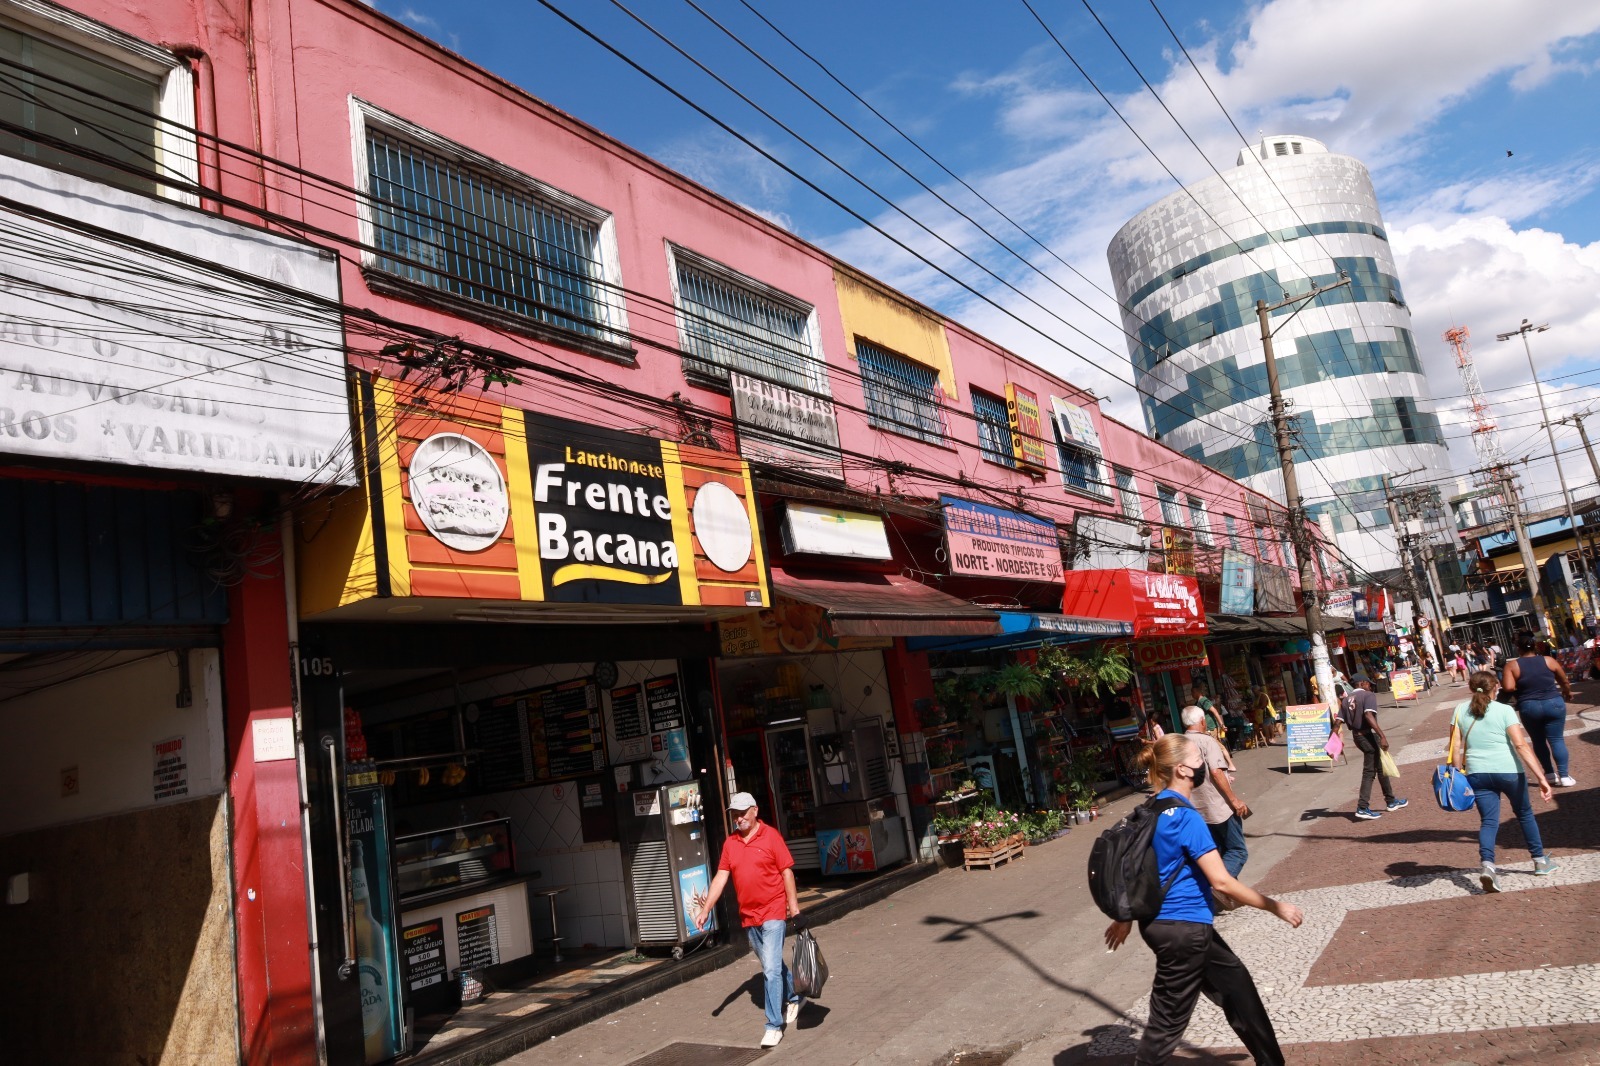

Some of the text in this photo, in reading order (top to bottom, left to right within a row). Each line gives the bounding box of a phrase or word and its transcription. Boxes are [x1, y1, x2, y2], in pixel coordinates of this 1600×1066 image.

[735, 375, 833, 415] DENTISTAS
[565, 445, 664, 480] Lanchonete
[534, 463, 672, 521] Frente
[539, 513, 679, 569] Bacana
[971, 538, 1045, 558] PRODUTOS TÍPICOS DO
[955, 552, 990, 571] NORTE
[995, 558, 1039, 576] NORDESTE
[1040, 564, 1046, 576] E
[1047, 563, 1062, 578] SUL
[723, 627, 747, 640] Caldo
[726, 639, 759, 653] de Cana
[1141, 639, 1204, 663] OURO
[301, 657, 334, 677] 105
[350, 817, 375, 835] ELADA
[404, 939, 443, 956] PÃO DE QUEIJO
[414, 961, 437, 973] SALGADO
